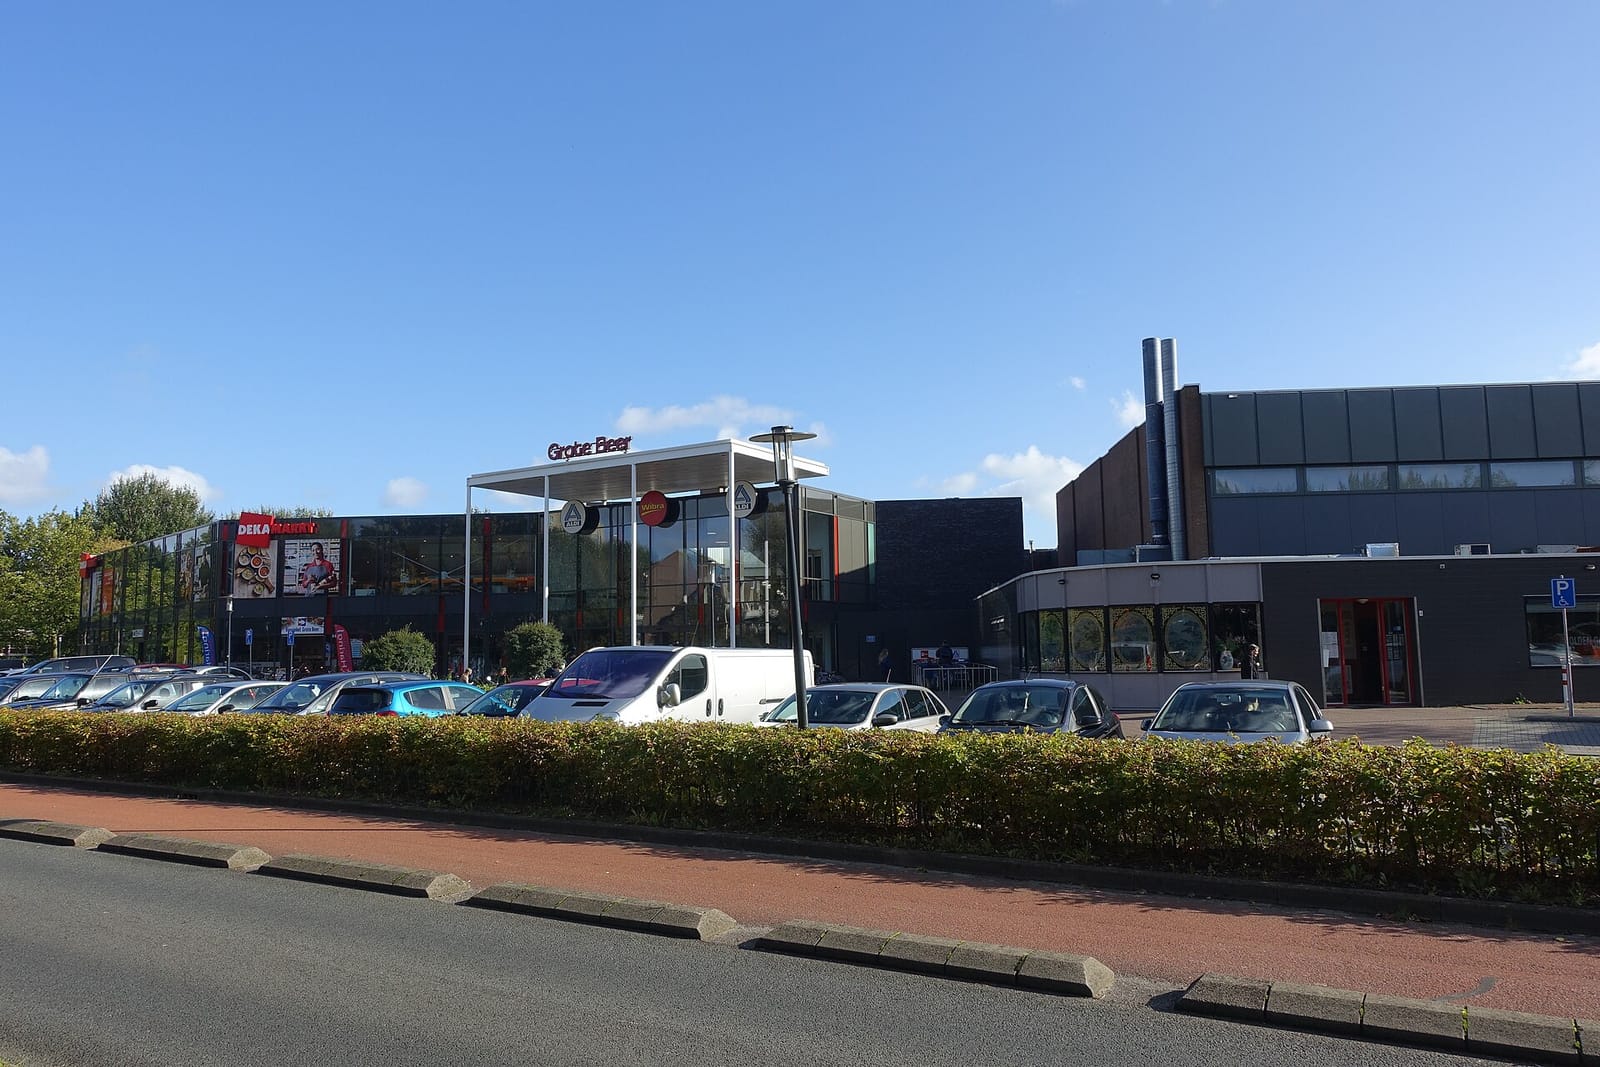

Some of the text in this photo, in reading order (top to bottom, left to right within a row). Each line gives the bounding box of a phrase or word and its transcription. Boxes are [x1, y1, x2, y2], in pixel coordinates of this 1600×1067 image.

[548, 436, 632, 460] Grote Beer
[641, 503, 664, 511] Wibra
[237, 523, 270, 535] DEKA
[1557, 580, 1569, 595] P
